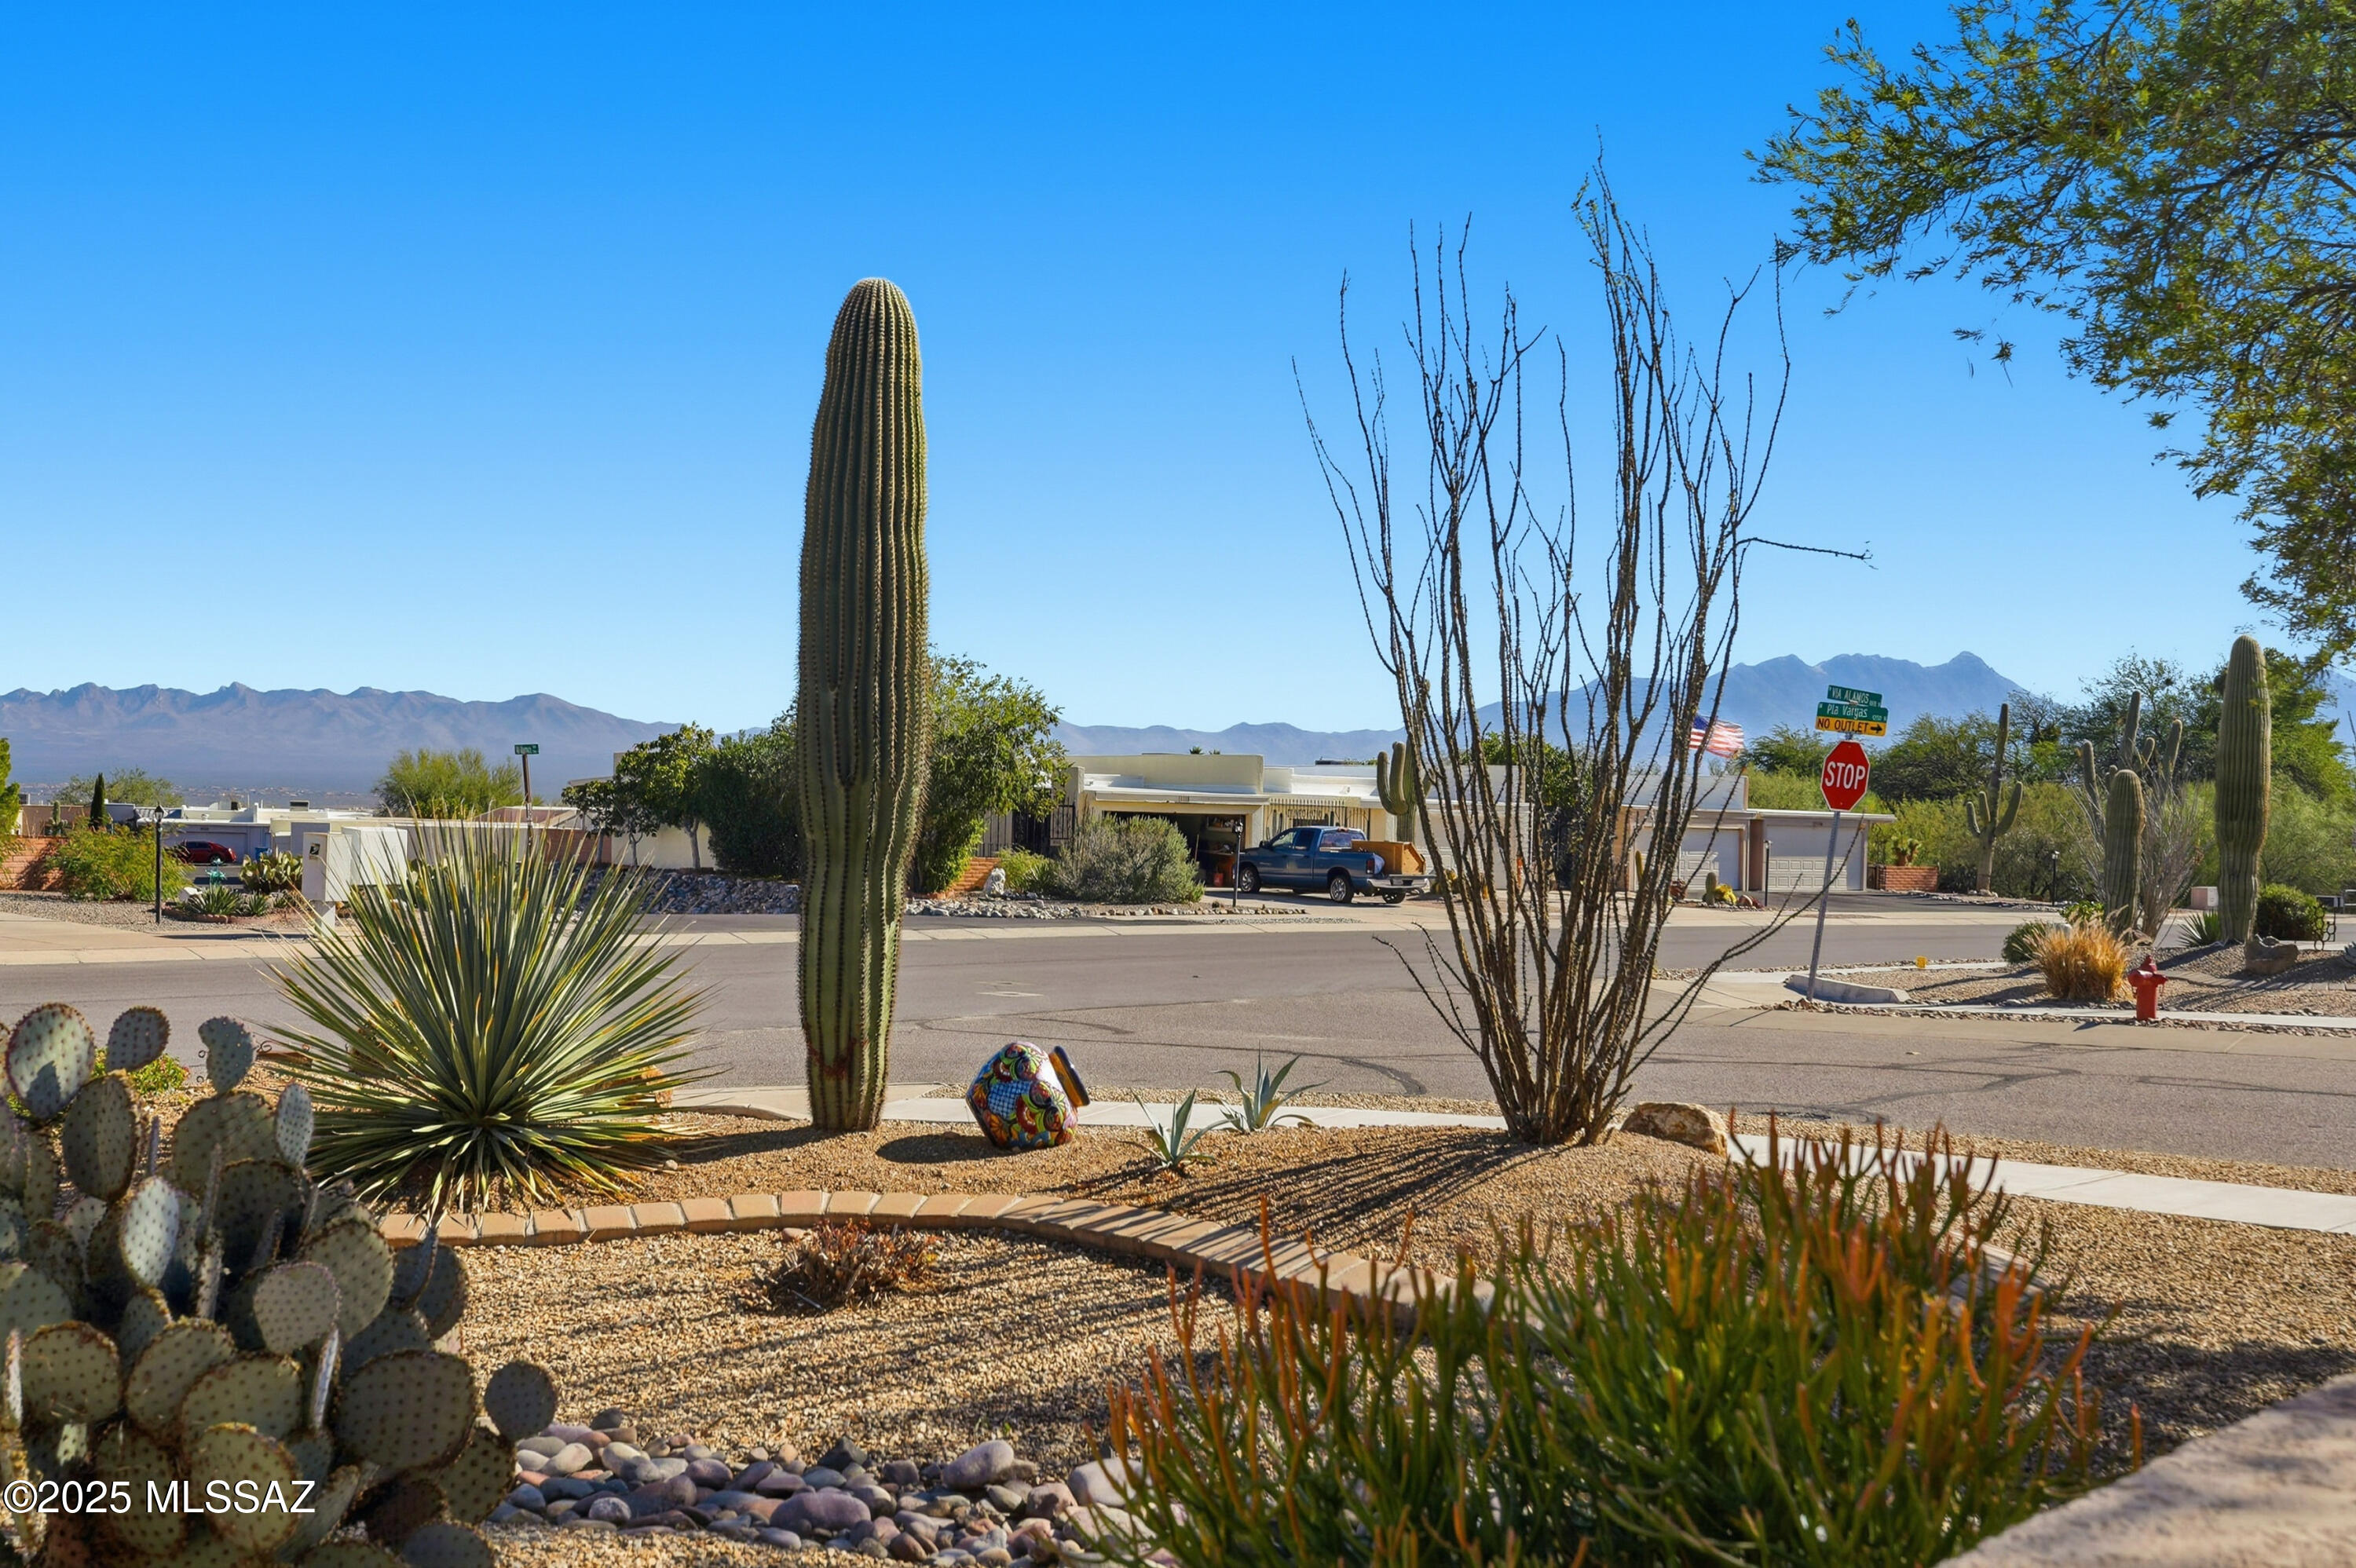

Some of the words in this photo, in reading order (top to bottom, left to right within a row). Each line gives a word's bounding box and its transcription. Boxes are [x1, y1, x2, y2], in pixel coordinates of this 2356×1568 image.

[1832, 688, 1842, 700] VIA
[1844, 689, 1869, 704] ALAMOS
[1827, 704, 1838, 715] Pla
[1842, 705, 1868, 720] Vargas
[1817, 718, 1831, 729] NO
[1834, 719, 1869, 733] OUTLET
[1824, 761, 1866, 790] STOP
